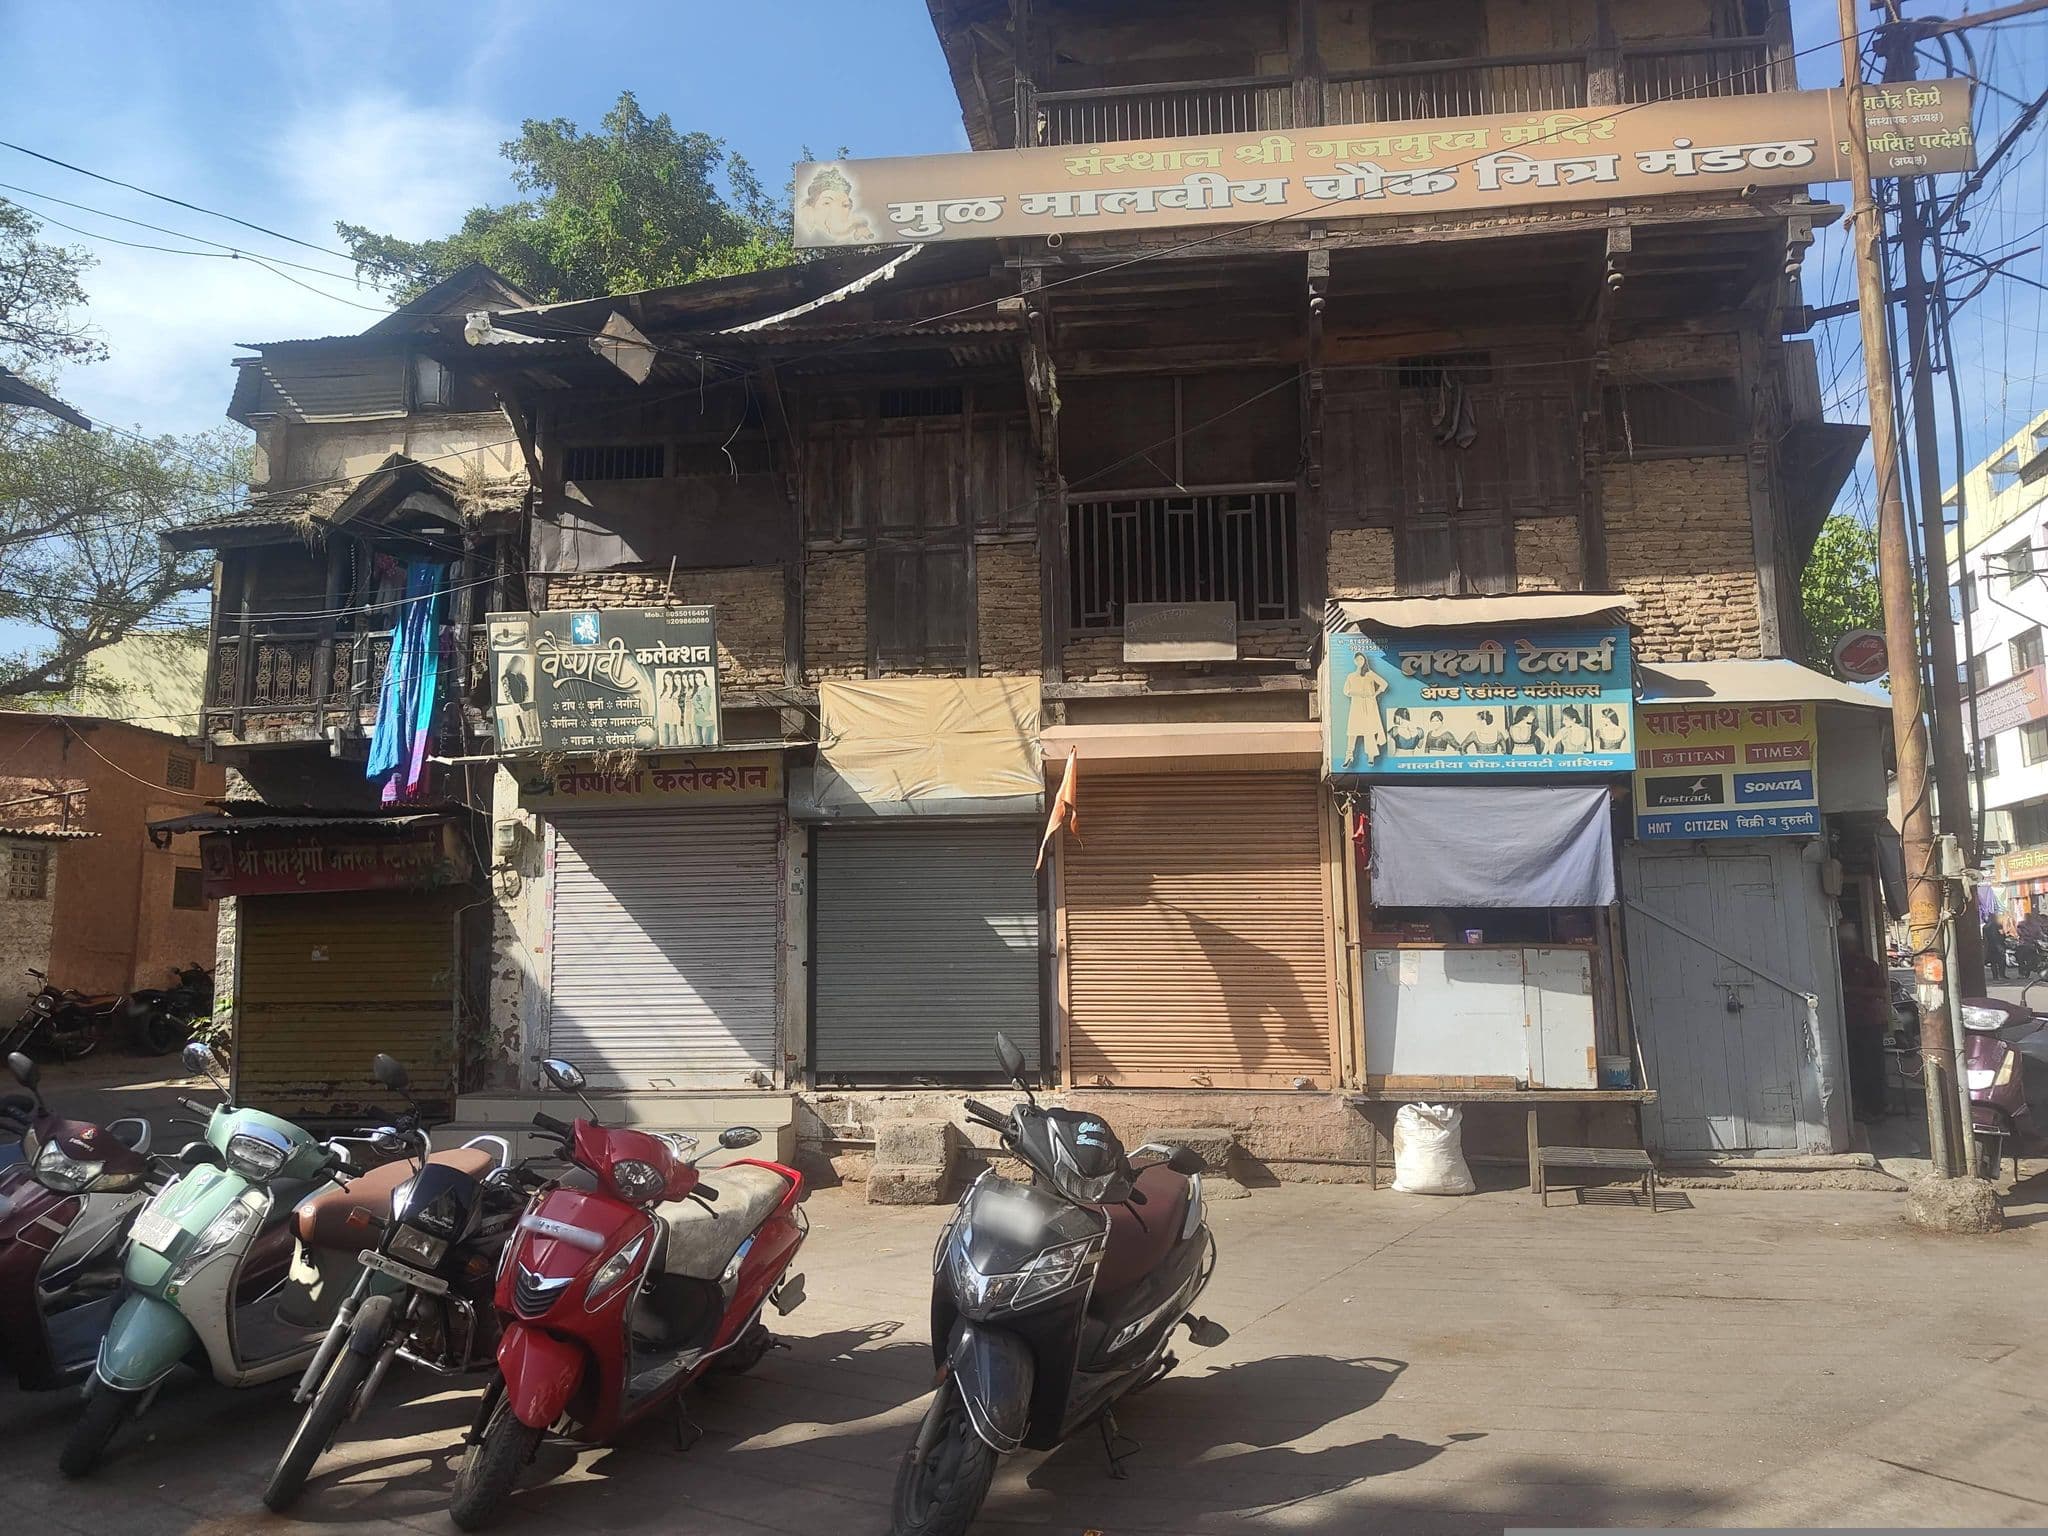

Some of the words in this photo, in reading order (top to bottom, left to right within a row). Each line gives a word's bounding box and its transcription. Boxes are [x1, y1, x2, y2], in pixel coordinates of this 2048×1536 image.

[1064, 147, 1222, 178] संस्थान
[1233, 134, 1295, 164] श्री
[1305, 128, 1491, 164] गजमुख
[1502, 116, 1617, 147] मंदिर
[889, 195, 1003, 238] मुळ
[1020, 173, 1288, 218] मालवीय
[1304, 162, 1457, 200] चौक
[1473, 152, 1619, 190] मित्र
[1634, 138, 1816, 177] मंडळ
[635, 640, 710, 665] कलेक्शन
[1399, 640, 1506, 677] लक्ष्मी
[1515, 636, 1617, 674] टेलर्स
[1642, 704, 1741, 740] साईनाथ
[1747, 704, 1804, 729] वाच
[1678, 750, 1725, 763] TITAN
[1751, 745, 1804, 759] TIMEX
[652, 760, 769, 795] कलेक्शन
[1743, 779, 1802, 793] SONATA
[1658, 792, 1712, 804] fastrack
[1647, 822, 1672, 834] HMT
[1684, 819, 1729, 832] CITIZEN
[1735, 814, 1765, 829] विक्री
[1767, 817, 1777, 826] व
[1780, 812, 1814, 831] दुरुस्ती
